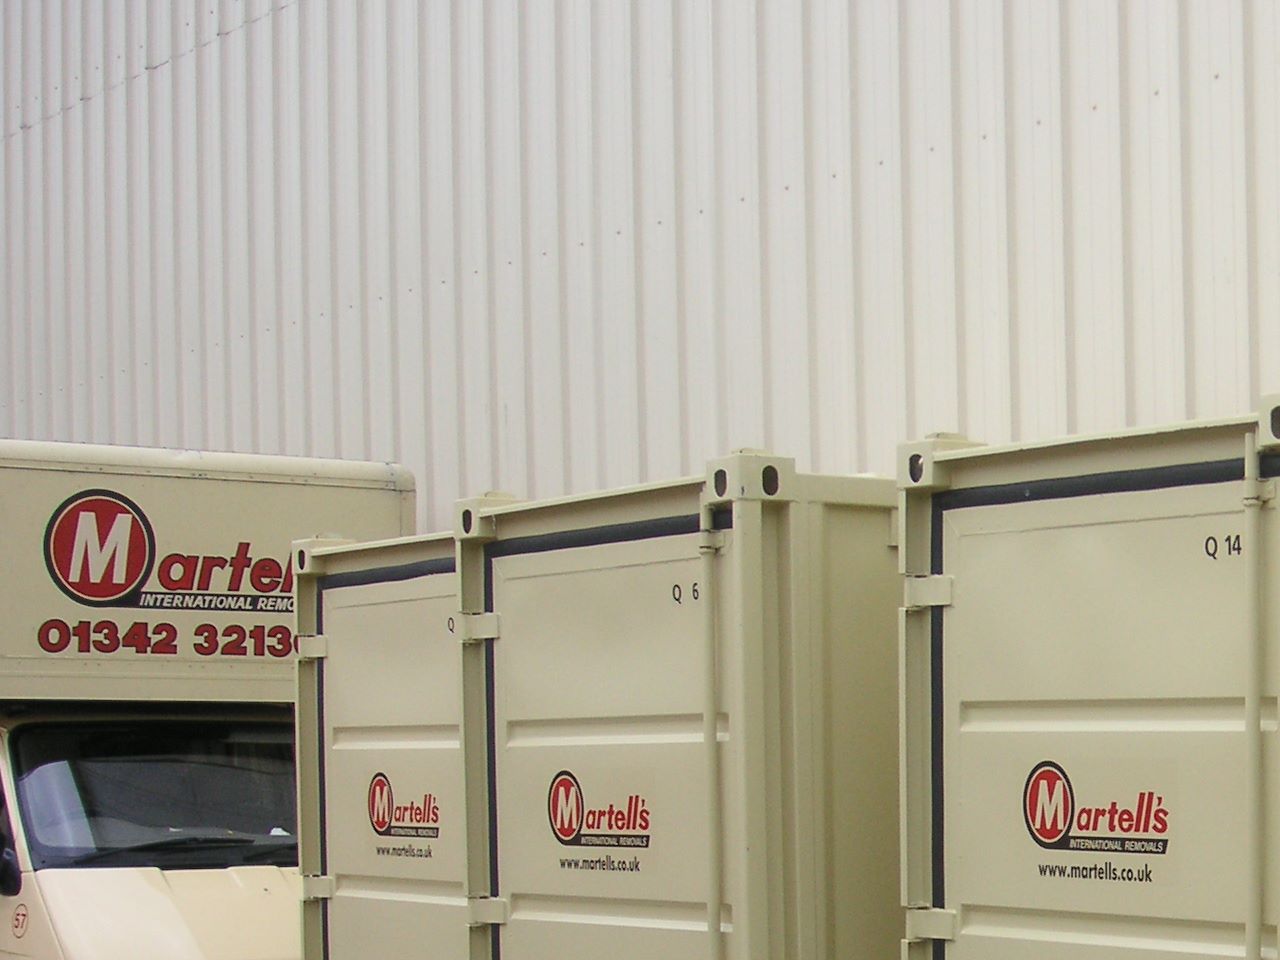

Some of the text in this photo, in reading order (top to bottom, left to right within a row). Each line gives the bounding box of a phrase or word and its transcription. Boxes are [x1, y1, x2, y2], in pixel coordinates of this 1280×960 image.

[1204, 534, 1242, 560] Q 14
[140, 593, 254, 610] INTERNATIONAL
[672, 582, 699, 604] Q 6
[447, 617, 455, 634] Q
[37, 619, 300, 658] 01342 3213
[374, 785, 439, 824] Martell's
[556, 786, 650, 831] Martell's
[1034, 779, 1169, 834] Martell's
[1069, 838, 1164, 853] INTERNATIONAL REMOVALS
[559, 855, 641, 872] www.martells.co.uk
[1038, 862, 1153, 883] www.martells.co.uk
[15, 912, 26, 929] 57
